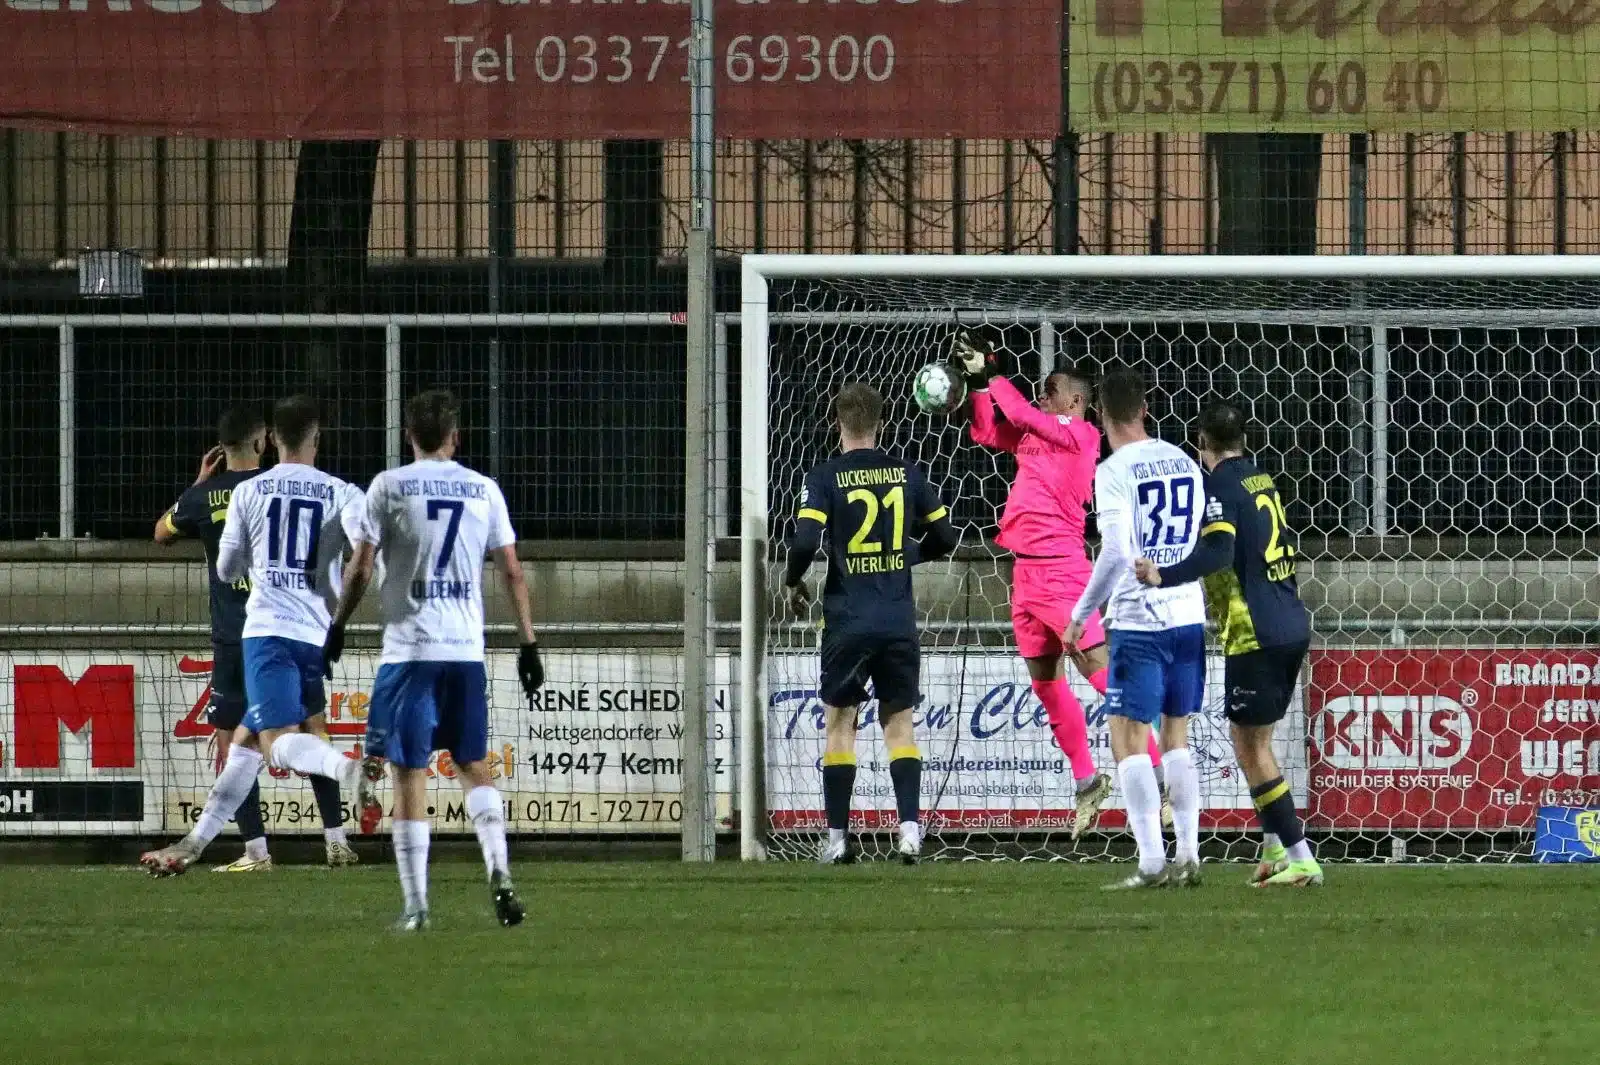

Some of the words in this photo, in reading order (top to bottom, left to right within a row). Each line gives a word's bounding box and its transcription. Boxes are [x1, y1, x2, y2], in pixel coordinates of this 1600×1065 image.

[443, 34, 515, 83] Tel
[726, 34, 896, 83] 69300
[1092, 61, 1287, 122] (03371)
[1306, 60, 1367, 115] 60
[1383, 60, 1441, 115] 40
[257, 479, 274, 495] VSG
[399, 479, 420, 497] VSG
[422, 480, 486, 500] ALTGLIENICKE
[836, 467, 908, 488] LUCKENWALDE
[846, 486, 905, 554] 21
[1137, 477, 1195, 548] 39
[266, 497, 323, 570] 10
[426, 499, 465, 577] 7
[845, 553, 904, 574] VIERLING
[528, 682, 591, 712] RENÉ
[529, 723, 663, 745] Nettgendorfer
[1321, 706, 1466, 760] KNS
[528, 752, 607, 775] 14947
[920, 755, 1064, 775] bäudereinigung
[1314, 774, 1395, 788] SCHILDER
[1399, 774, 1473, 788] SYSTEME
